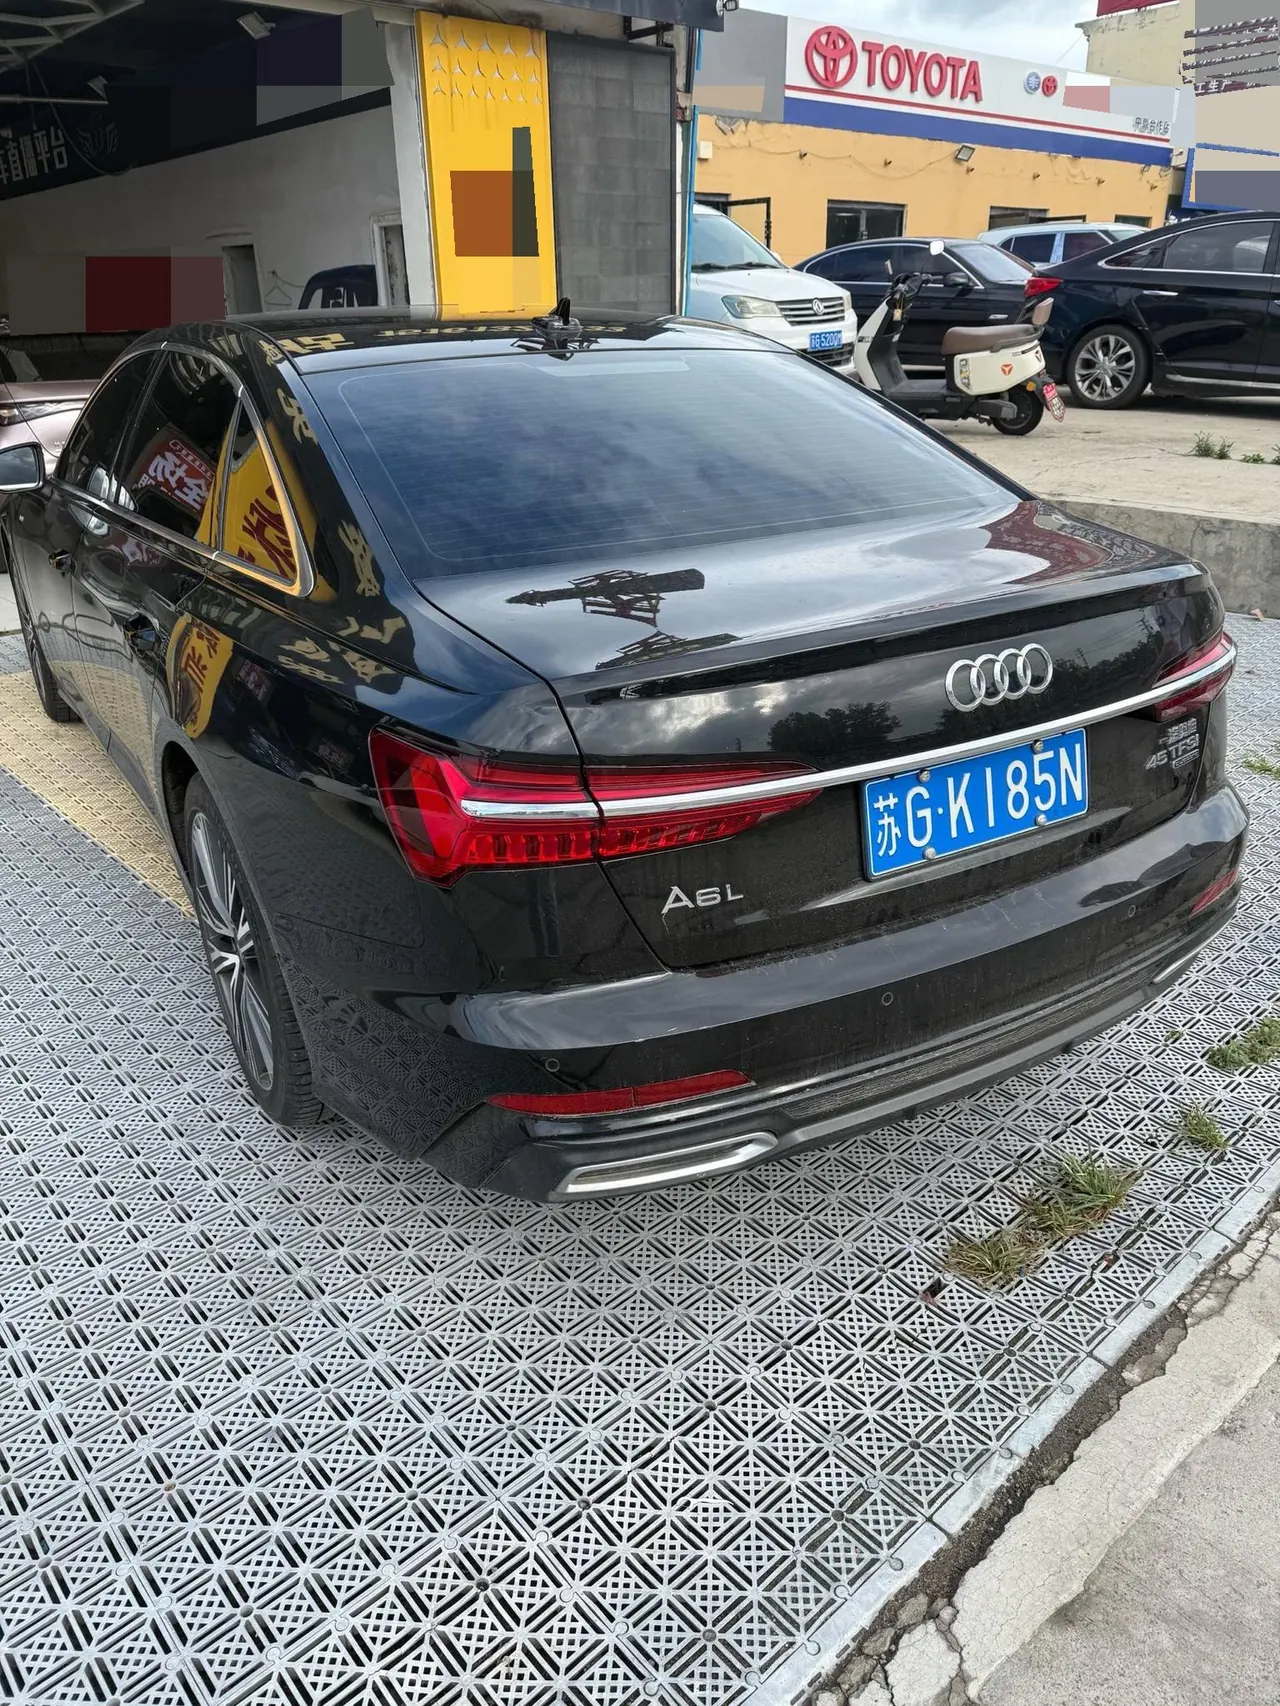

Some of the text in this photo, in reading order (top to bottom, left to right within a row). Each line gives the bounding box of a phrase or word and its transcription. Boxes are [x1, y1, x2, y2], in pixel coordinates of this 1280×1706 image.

[862, 40, 983, 103] TOYOTA
[1168, 734, 1200, 758] TFSI
[661, 884, 744, 914] A6L
